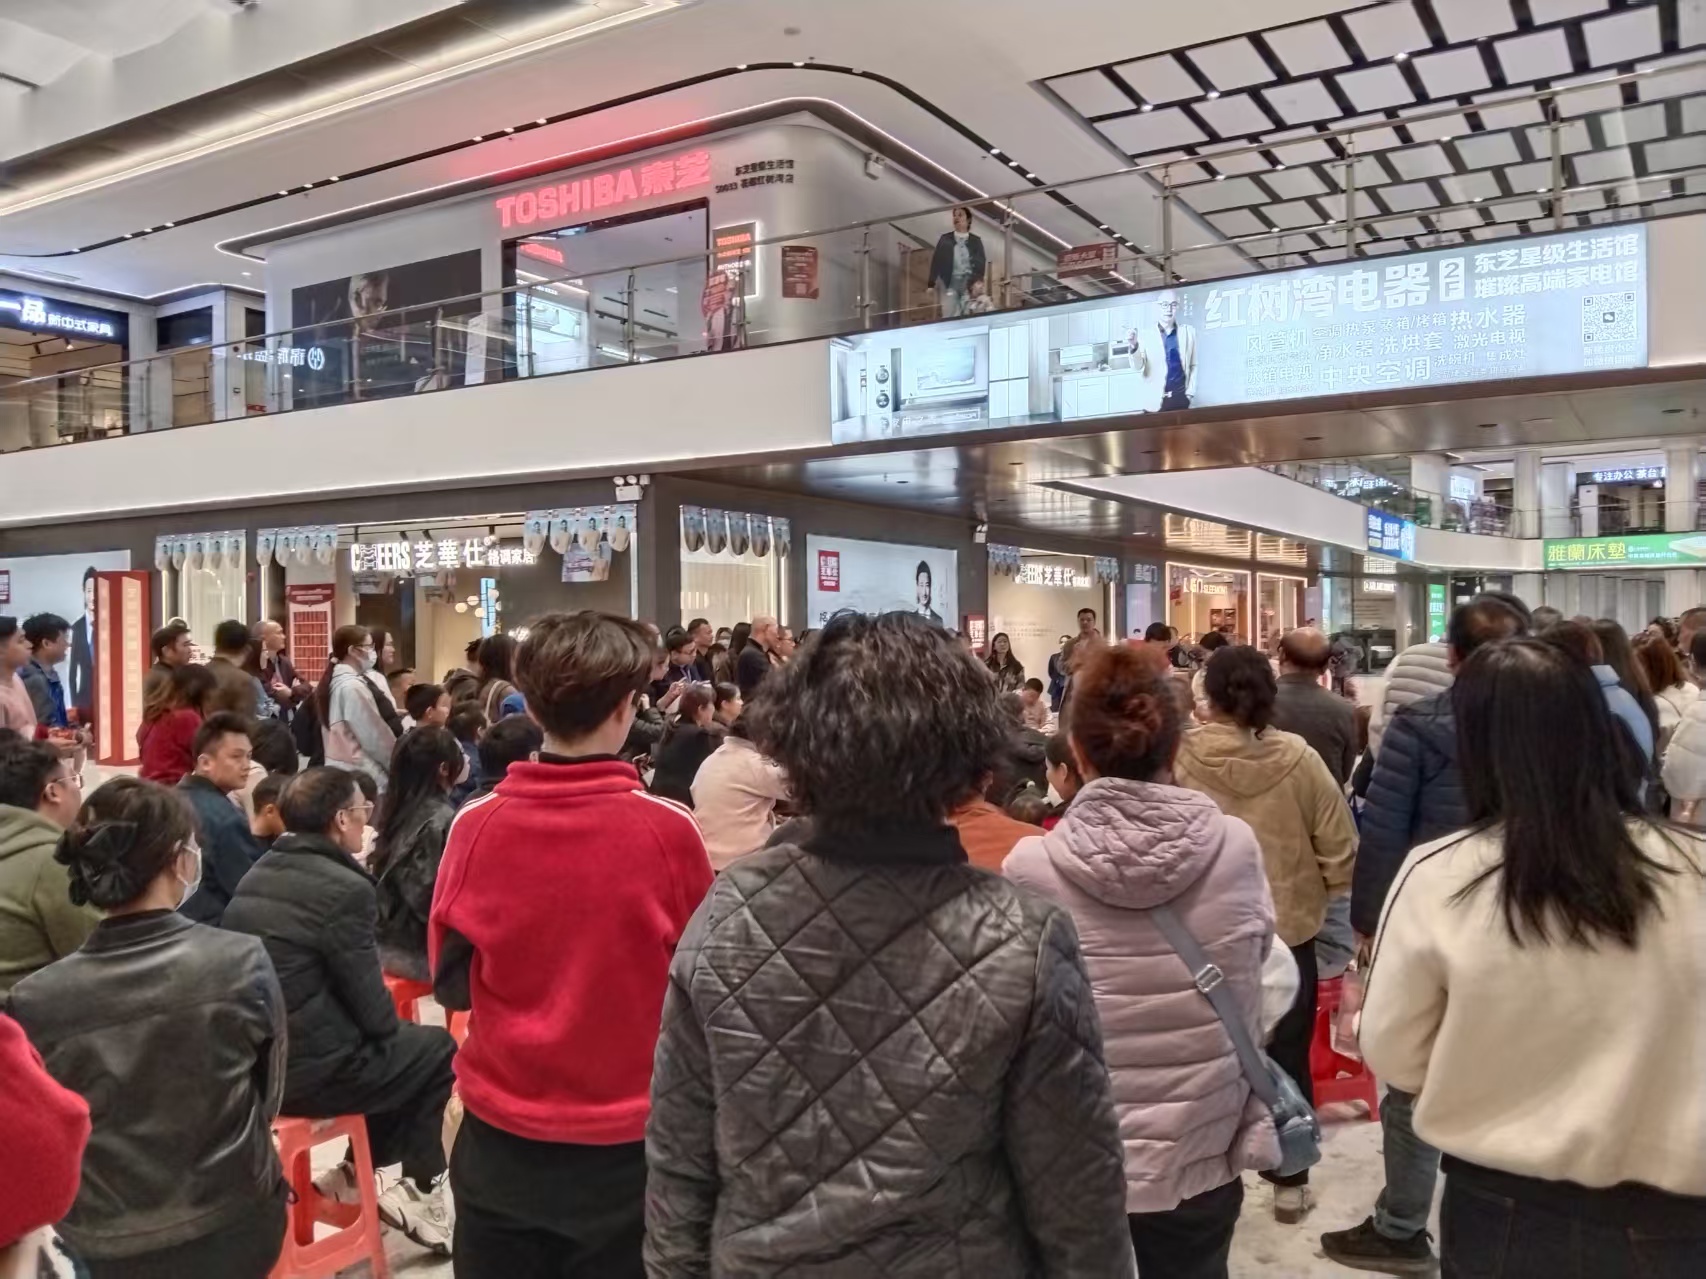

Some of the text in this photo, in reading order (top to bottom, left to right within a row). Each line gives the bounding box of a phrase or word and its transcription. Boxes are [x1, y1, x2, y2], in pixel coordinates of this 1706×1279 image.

[496, 169, 638, 228] TOSHIBA
[1474, 232, 1639, 273] 东芝星级生活馆
[1204, 262, 1431, 331] 红树湾电器
[1474, 260, 1639, 299] 璀璨高端家电馆
[1246, 328, 1309, 353] 风管机
[1450, 304, 1526, 332] 热水器
[1315, 340, 1373, 361] 净水器
[1381, 332, 1443, 356] 洗烘套
[1453, 328, 1526, 350] 激光电视
[1319, 356, 1431, 391] 中央空调
[1434, 352, 1475, 367] 洗碗机
[1487, 349, 1526, 361] 集成灶
[1594, 470, 1634, 482] 专注办公
[351, 540, 411, 571] CHEERS
[414, 537, 484, 569] 芝華仕
[1548, 542, 1626, 562] 雅蘭床墊
